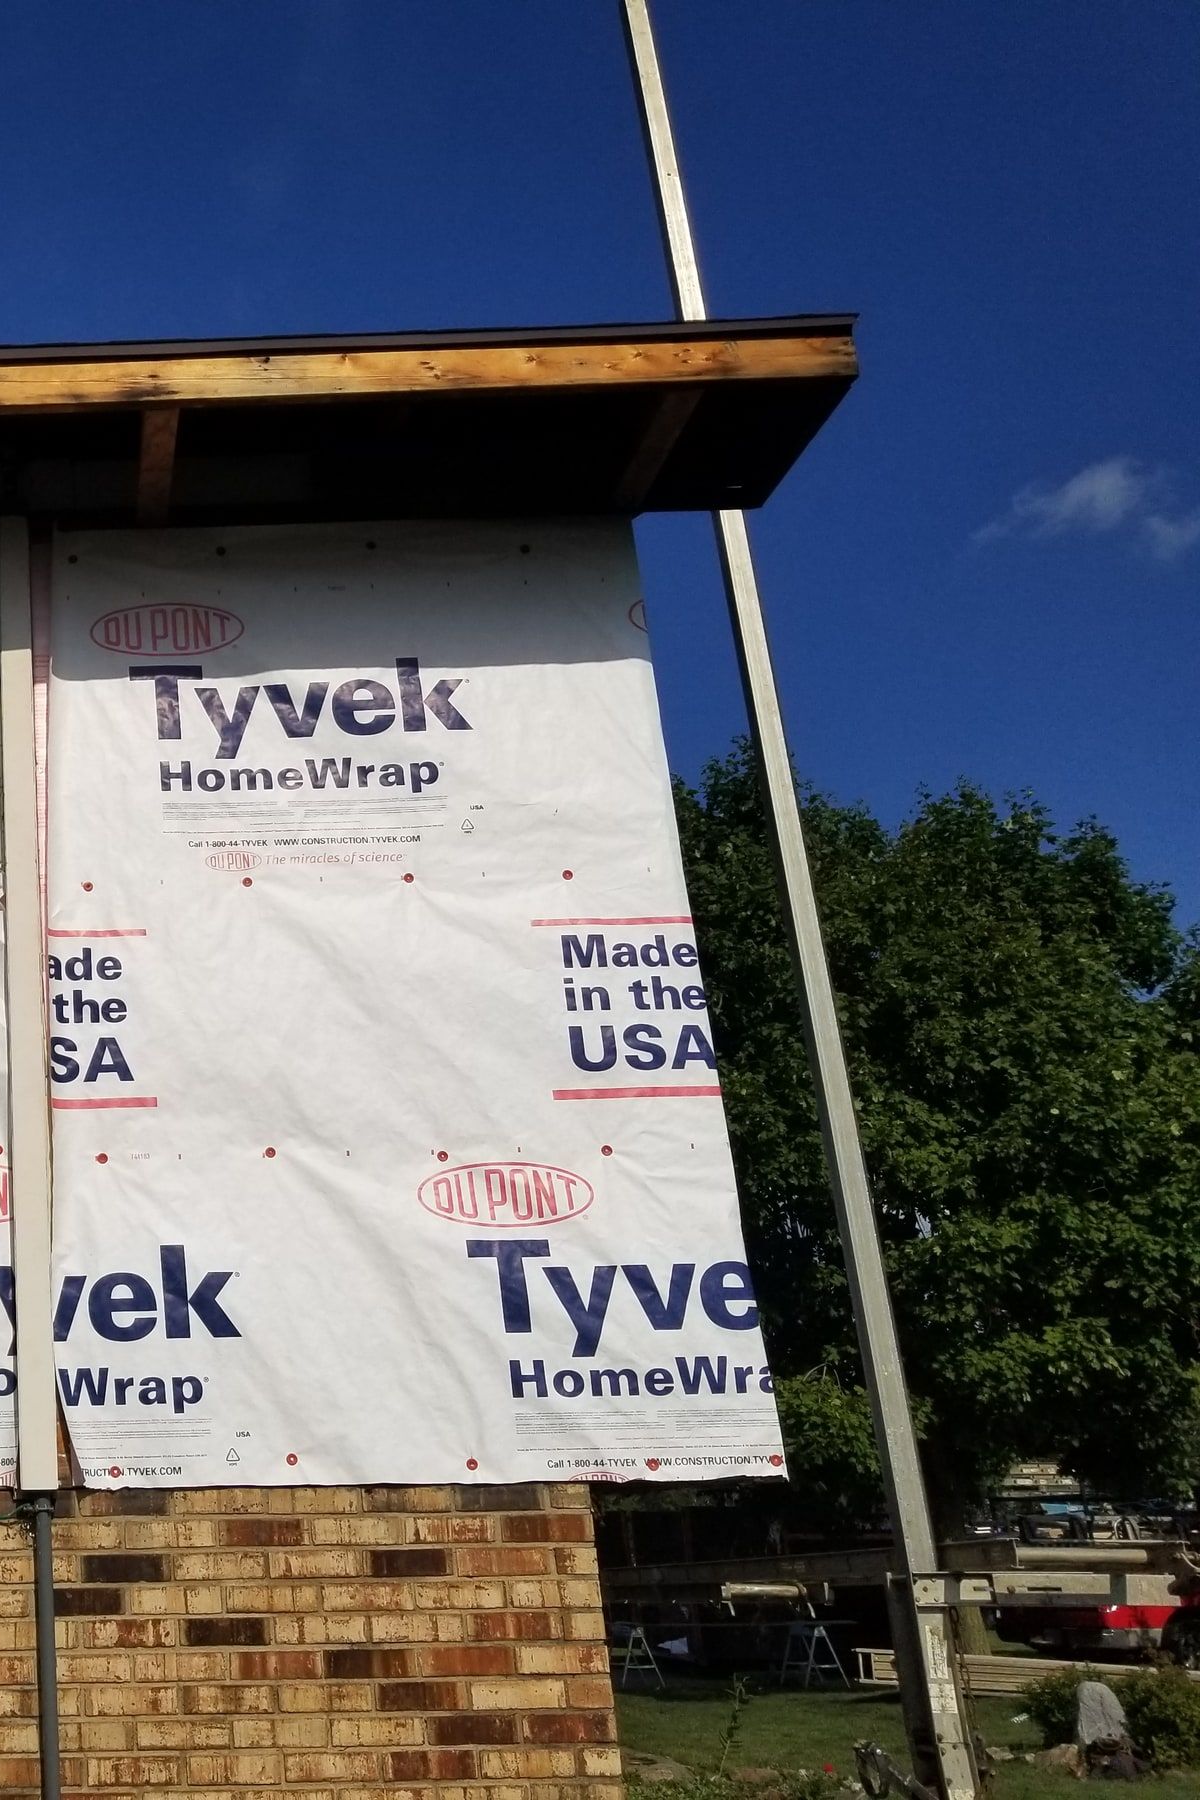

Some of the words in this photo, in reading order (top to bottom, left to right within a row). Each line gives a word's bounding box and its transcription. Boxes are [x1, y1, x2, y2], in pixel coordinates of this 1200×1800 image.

[129, 657, 474, 759] Tyvek
[159, 757, 439, 793] HomeWrap
[188, 840, 203, 848] Call
[205, 839, 268, 848] 1-800-44-TYVEK
[274, 835, 421, 846] WWW.CONSTRUCTION.TYVEK.COM
[265, 854, 285, 865] The
[290, 853, 340, 864] miracles
[343, 852, 357, 864] of
[358, 851, 403, 863] science
[48, 948, 123, 981] ade
[561, 934, 698, 968] Made
[52, 990, 127, 1023] the
[563, 977, 611, 1011] in
[628, 976, 708, 1010] the
[50, 1036, 135, 1084] SA
[568, 1024, 718, 1072] USA
[466, 1239, 761, 1357] Tyve
[509, 1356, 775, 1398] HomeWra
[547, 1460, 565, 1468] Call
[567, 1459, 638, 1468] 1-800-44-TYVEK
